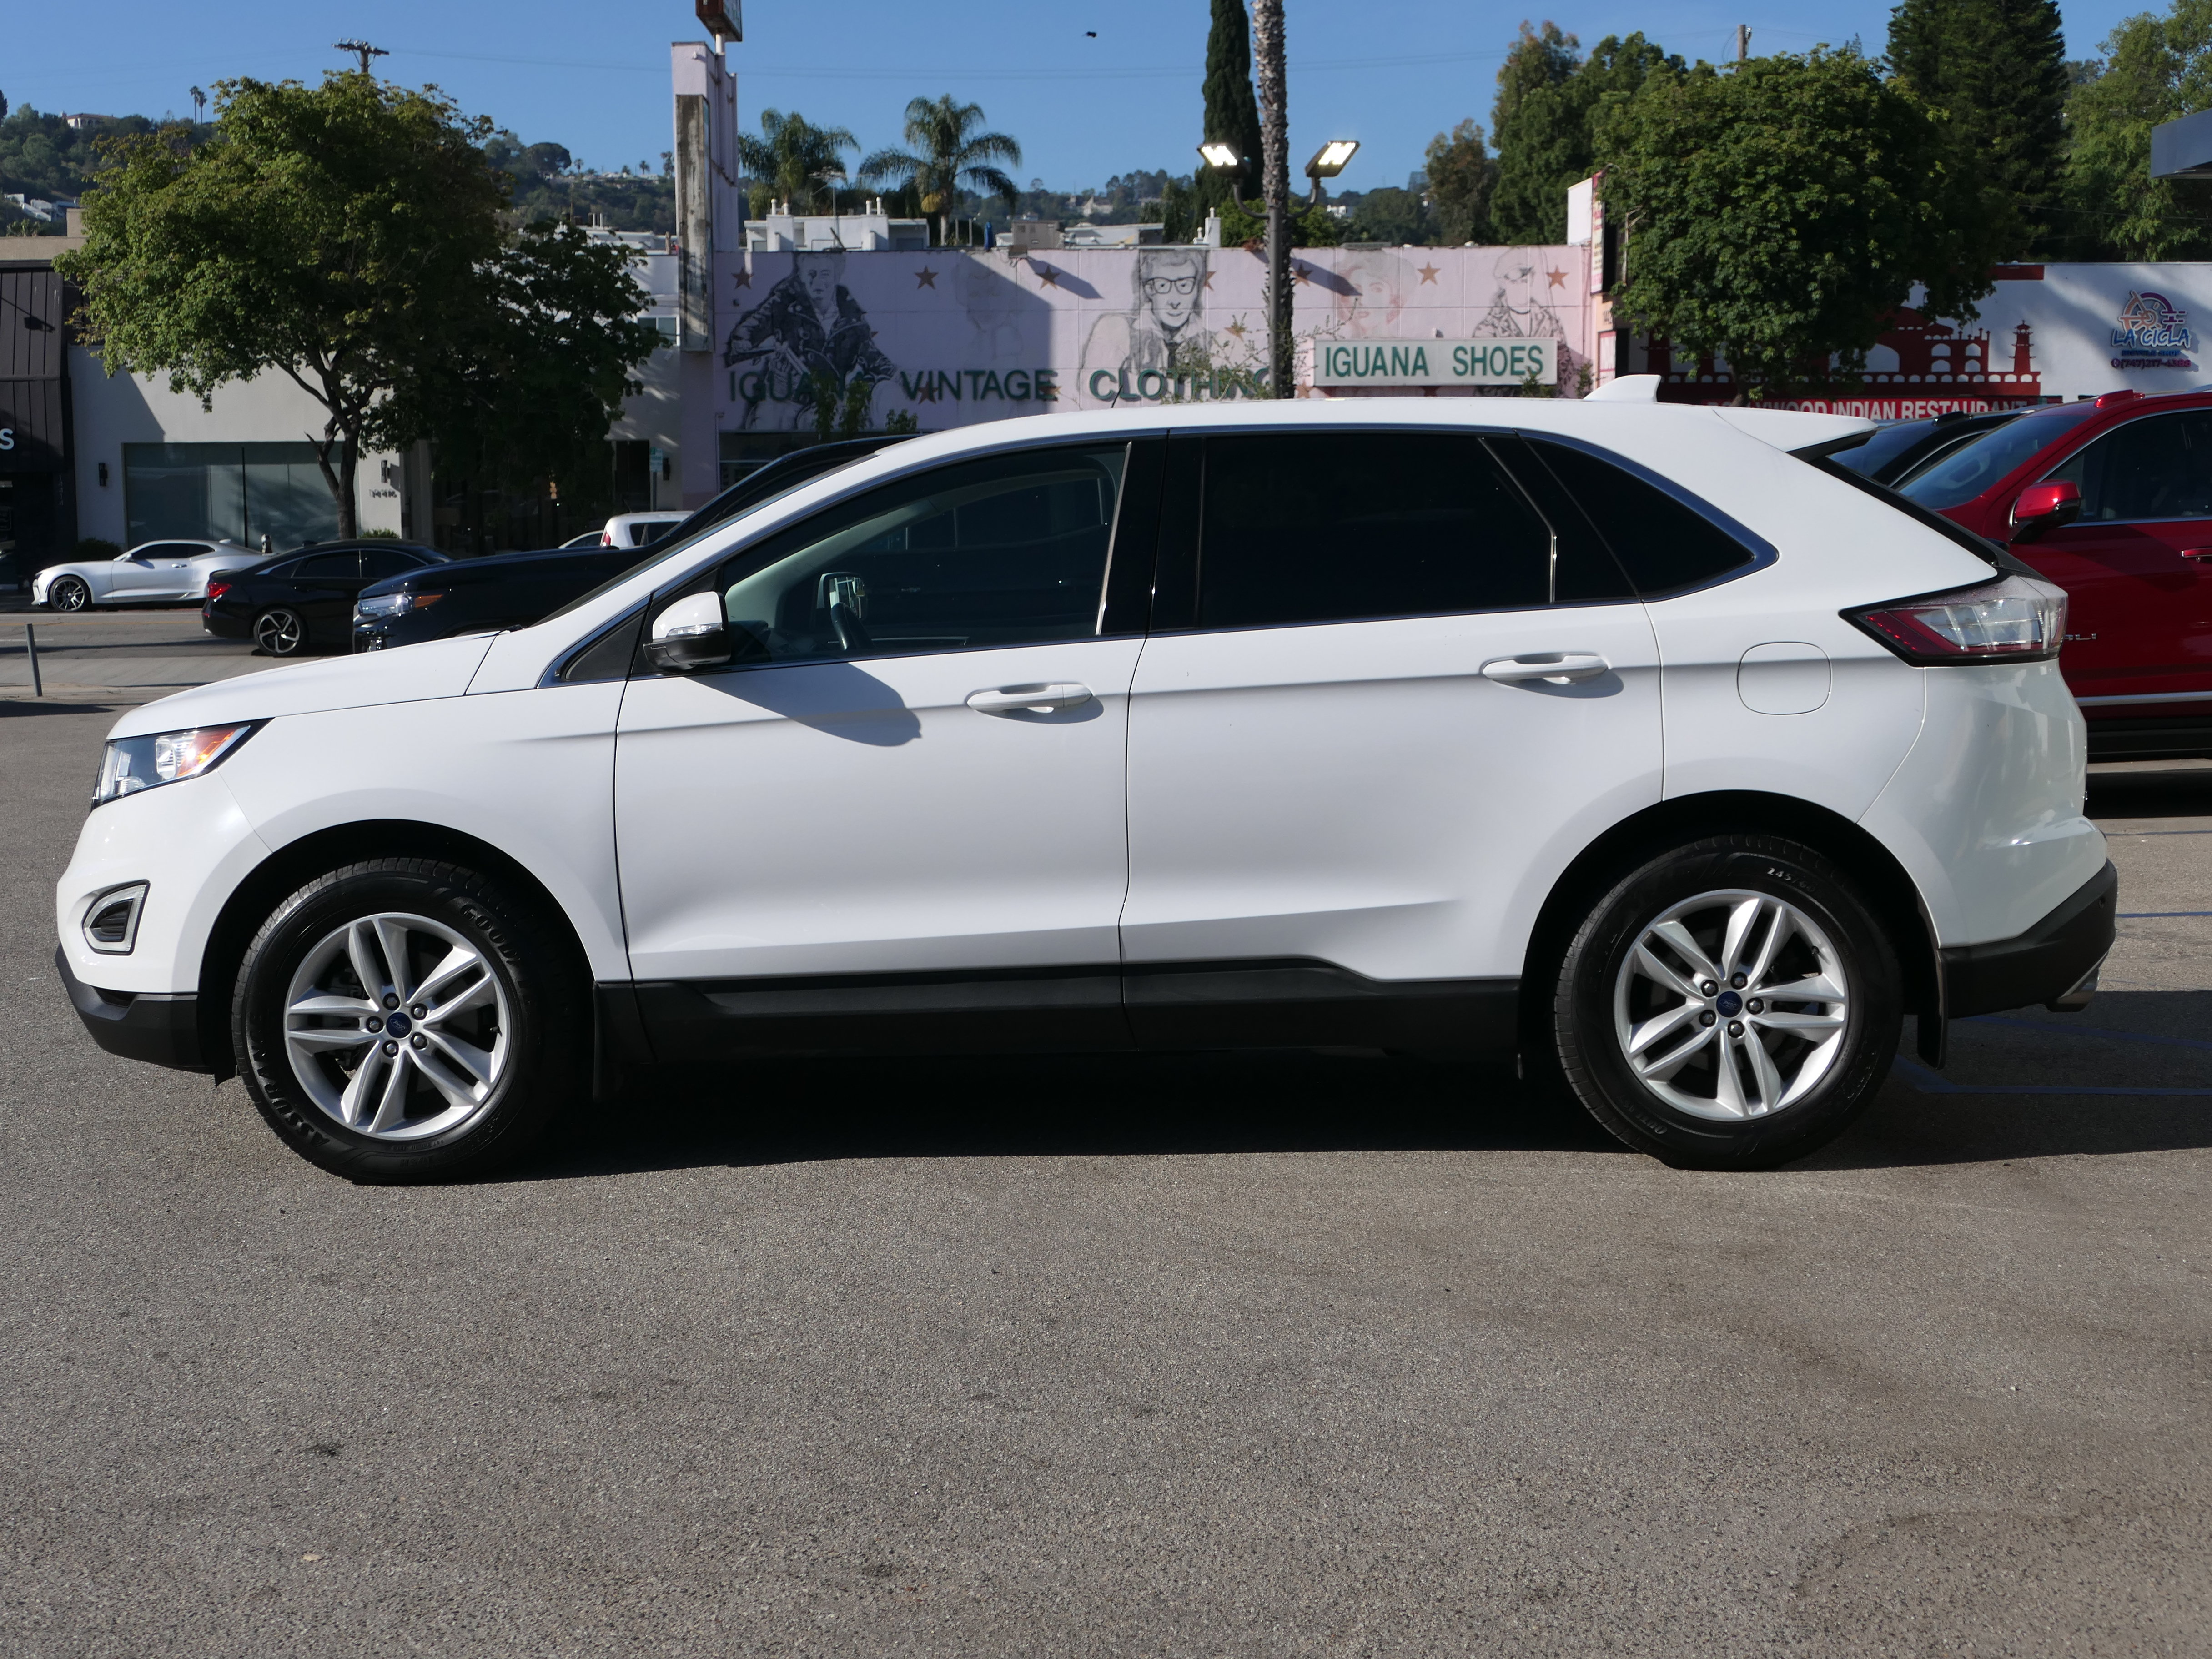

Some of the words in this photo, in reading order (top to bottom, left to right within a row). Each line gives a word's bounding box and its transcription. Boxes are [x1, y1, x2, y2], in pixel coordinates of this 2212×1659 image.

[2113, 328, 2137, 347] LA
[2141, 328, 2190, 347] CICLA
[1326, 347, 1429, 377] IGUANA
[1453, 345, 1543, 376] SHOES
[730, 370, 870, 402] IGUA
[900, 369, 1058, 401] VINTAGE
[1832, 401, 1895, 420] INDIAN
